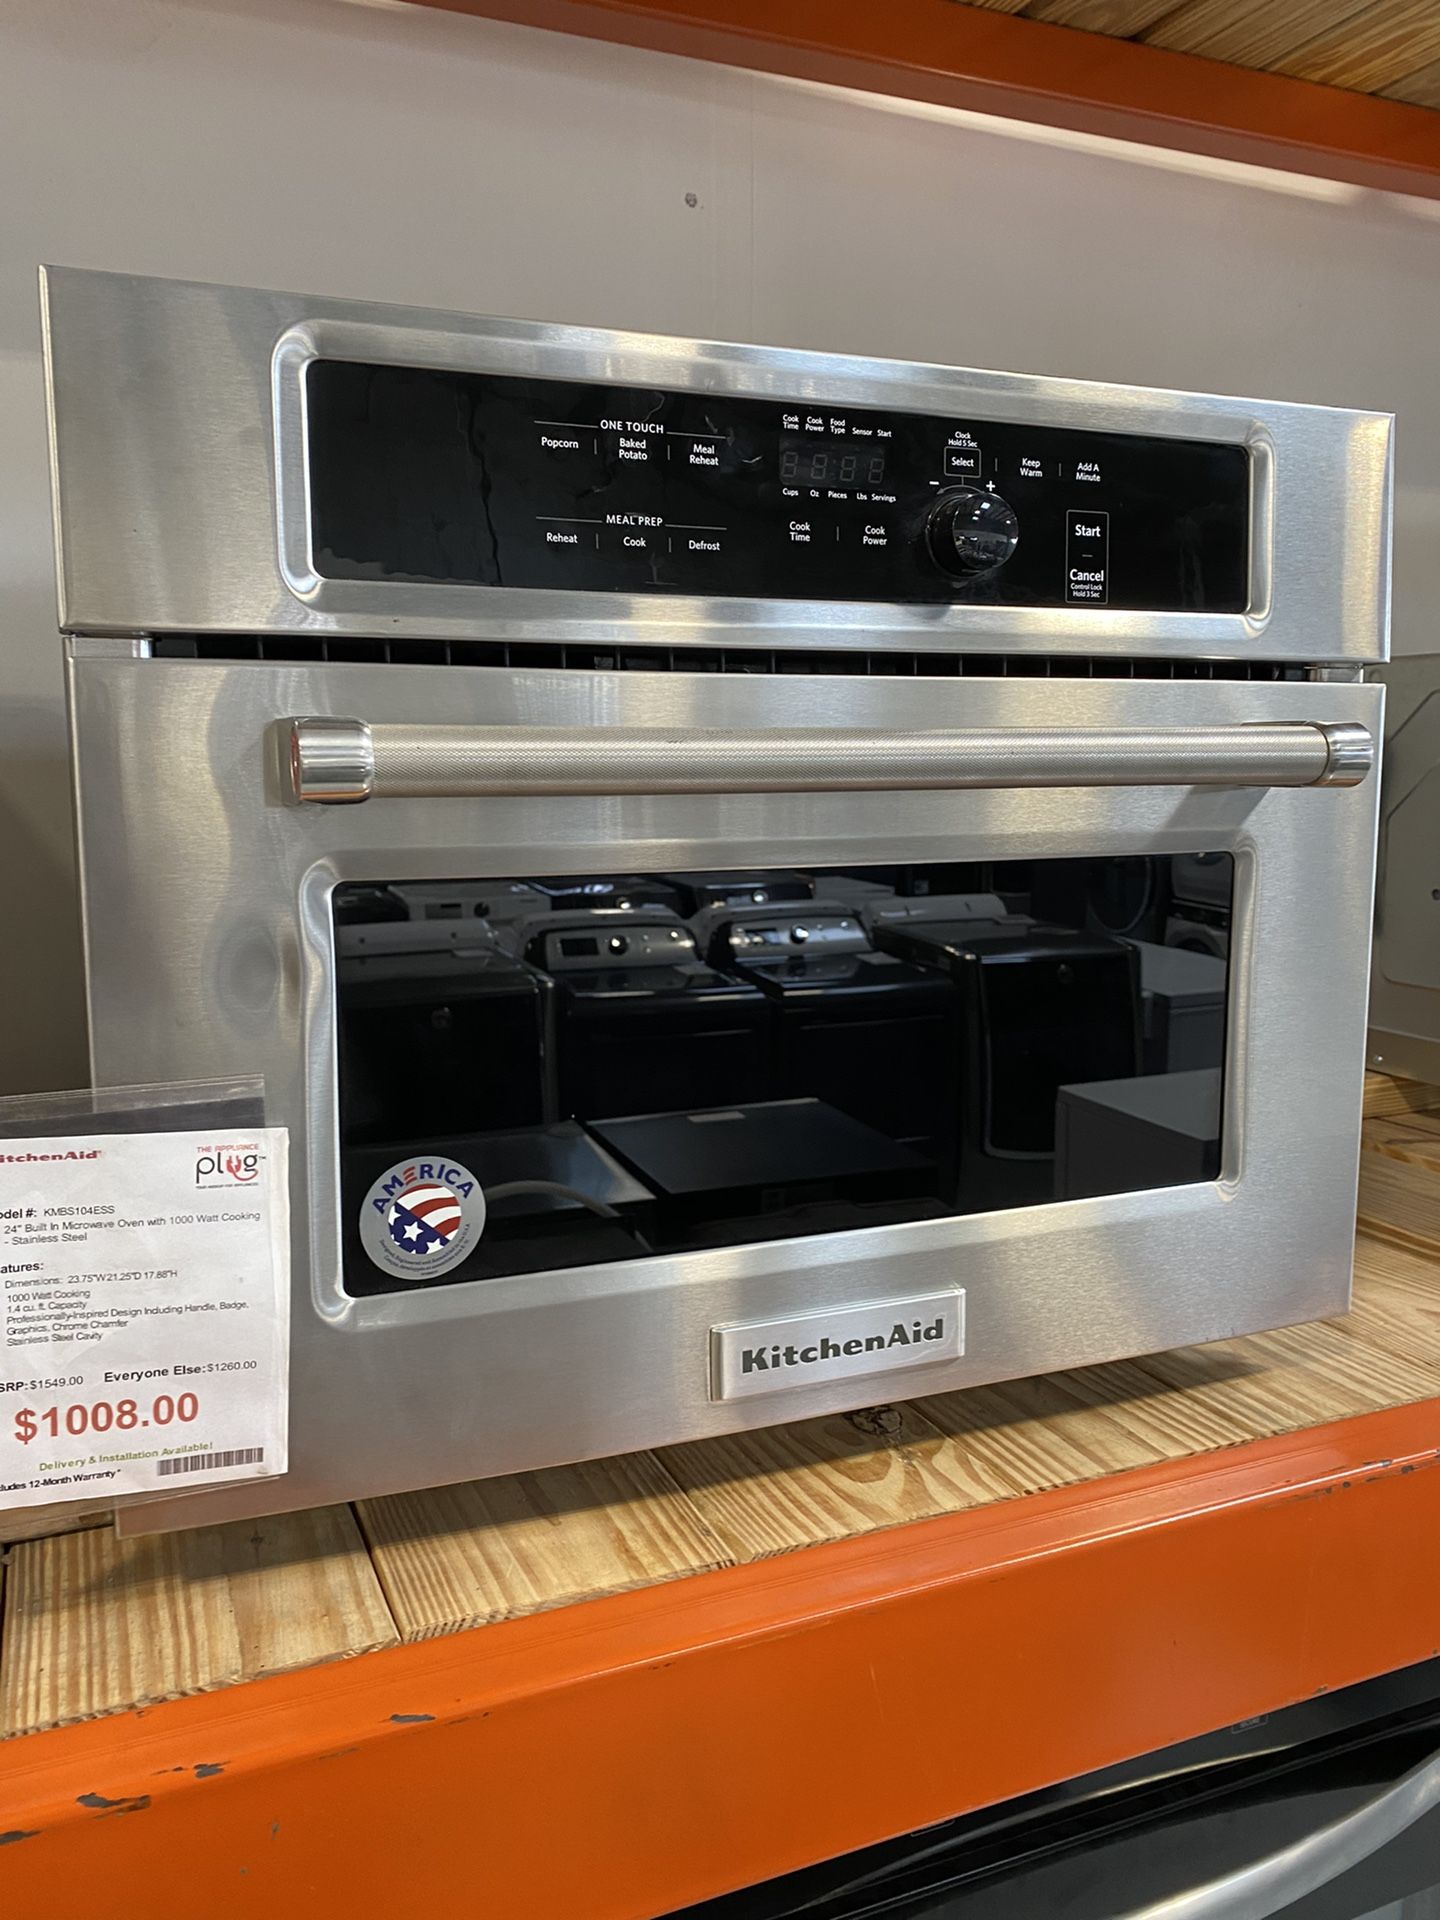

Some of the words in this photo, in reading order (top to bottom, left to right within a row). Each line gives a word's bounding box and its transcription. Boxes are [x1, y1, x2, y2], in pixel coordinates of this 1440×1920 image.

[783, 414, 799, 423] Cook
[806, 416, 823, 425] Cook
[830, 418, 845, 427] Food
[600, 420, 623, 430] ONE
[626, 422, 664, 434] TOUCH
[783, 422, 799, 430] Time
[805, 424, 824, 432] Power
[830, 426, 845, 434] Type
[852, 427, 873, 436] Sensor
[877, 429, 892, 438] Start
[954, 431, 972, 439] Clock
[541, 437, 579, 449] Popcorn
[619, 438, 646, 449] Baked
[693, 444, 715, 454] Meal
[618, 450, 648, 461] Potato
[689, 455, 719, 466] Reheat
[951, 456, 974, 467] Select
[1022, 458, 1041, 468] Keep
[1020, 468, 1043, 478] Warm
[1077, 463, 1092, 472] Add
[1092, 464, 1100, 472] A
[1075, 472, 1101, 482] Minute
[782, 488, 799, 496] Cups
[810, 490, 819, 498] Oz
[828, 491, 848, 499] Pieces
[871, 494, 897, 503] Servings
[606, 515, 635, 526] MEAL
[638, 516, 663, 527] PREP
[789, 521, 811, 531] Cook
[864, 525, 886, 535] Cook
[1075, 524, 1101, 537] Start
[546, 532, 578, 544] Reheat
[623, 537, 647, 547] Cook
[789, 532, 811, 542] Time
[862, 536, 888, 546] Power
[688, 540, 720, 551] Defrost
[1070, 569, 1104, 582] Cancel
[372, 1163, 474, 1214] AMERICA
[25, 1222, 47, 1232] Built
[50, 1222, 59, 1230] In
[62, 1219, 115, 1230] Microwave
[117, 1218, 144, 1228] Oven
[147, 1217, 166, 1226] with
[169, 1214, 194, 1225] 1000
[196, 1213, 219, 1223] Watt
[221, 1211, 261, 1221] Cooking
[12, 1234, 59, 1245] Stainless
[61, 1232, 88, 1242] Steel
[5, 1277, 62, 1289] Dimensions:
[8, 1292, 30, 1303] 1000
[53, 1289, 91, 1299] Cooking
[48, 1300, 87, 1311] Capacity
[110, 1307, 142, 1319] Design
[144, 1304, 183, 1315] Including
[52, 1322, 88, 1332] Chrome
[90, 1318, 128, 1329] Chamfer
[6, 1336, 49, 1347] Stainless
[51, 1333, 74, 1343] Steel
[76, 1331, 104, 1342] Cavity
[742, 1318, 944, 1374] KitchenAid
[104, 1367, 169, 1383] Everyone
[14, 1391, 199, 1445] $1008.00
[39, 1459, 86, 1472] Delivery
[88, 1456, 97, 1465] &
[99, 1449, 159, 1463] Installation
[161, 1441, 213, 1457] Available!
[29, 1475, 72, 1489] 12-Month
